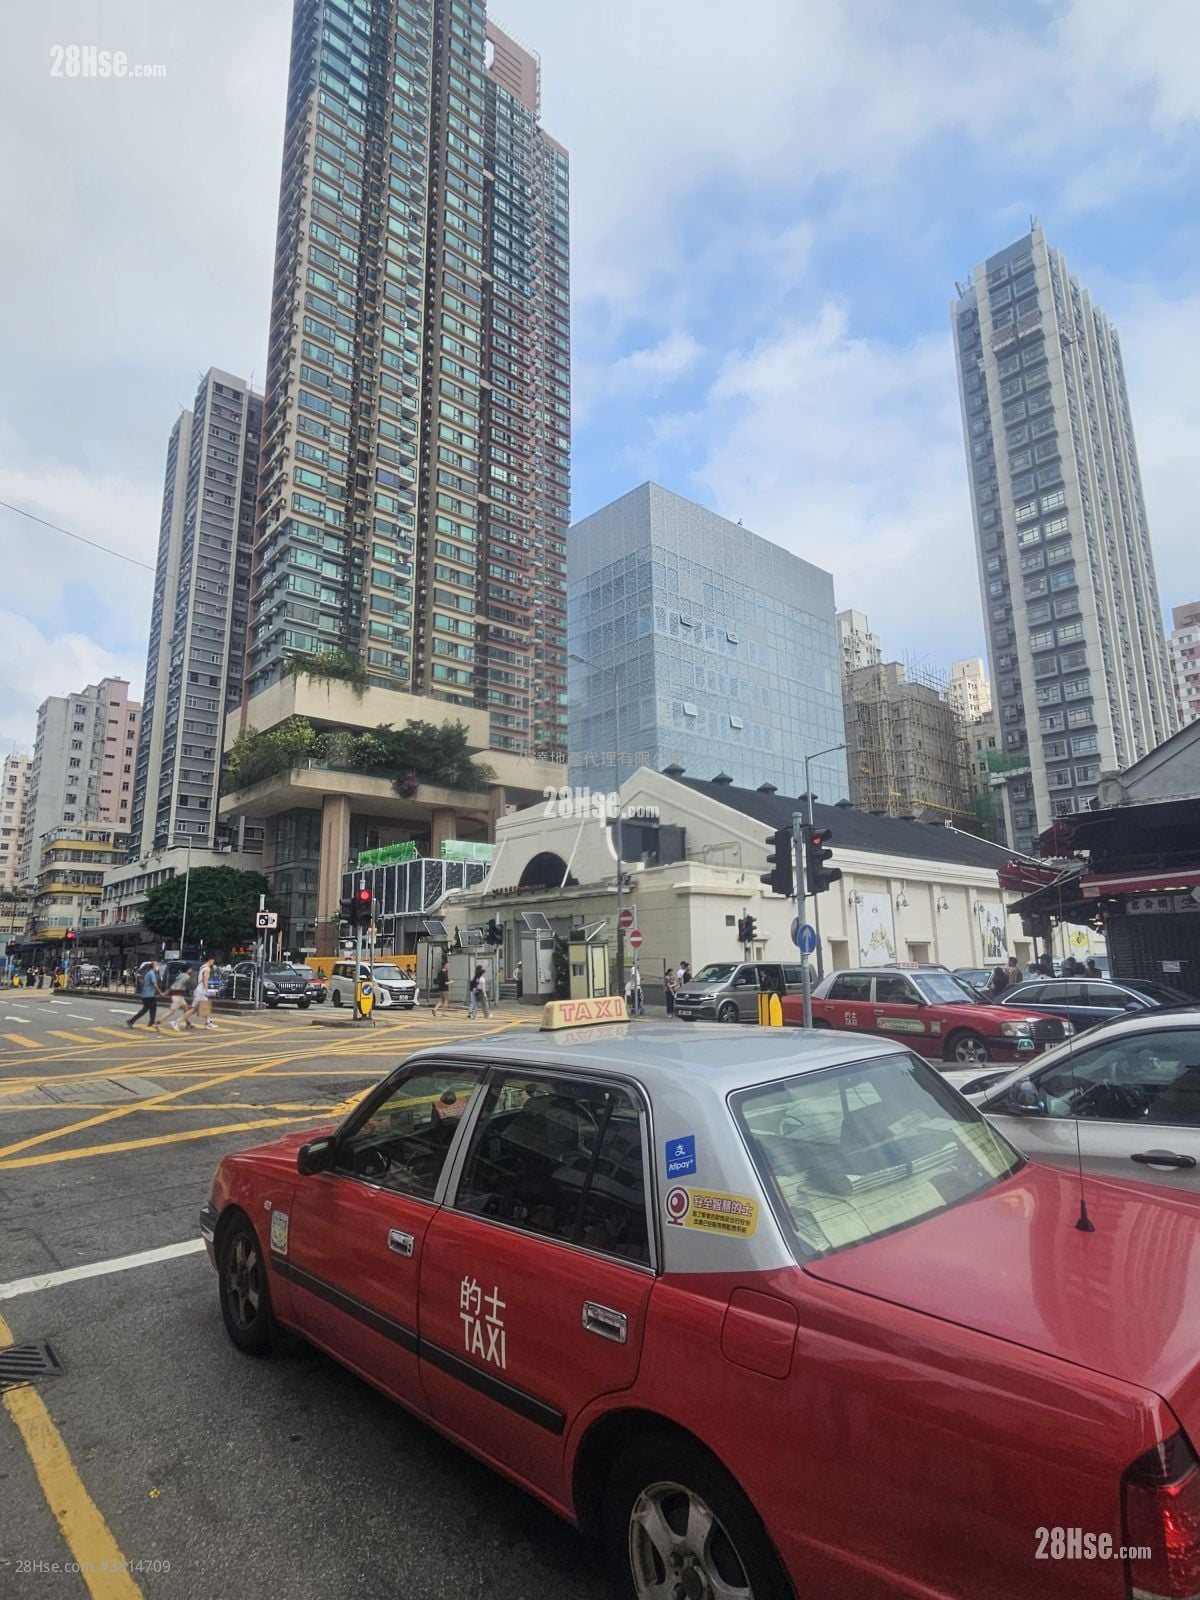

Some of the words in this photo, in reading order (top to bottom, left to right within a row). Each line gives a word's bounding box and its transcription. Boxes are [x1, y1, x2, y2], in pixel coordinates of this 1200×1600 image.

[560, 1000, 623, 1022] TAXI
[460, 1275, 506, 1327] 的士
[460, 1311, 506, 1370] TAXI
